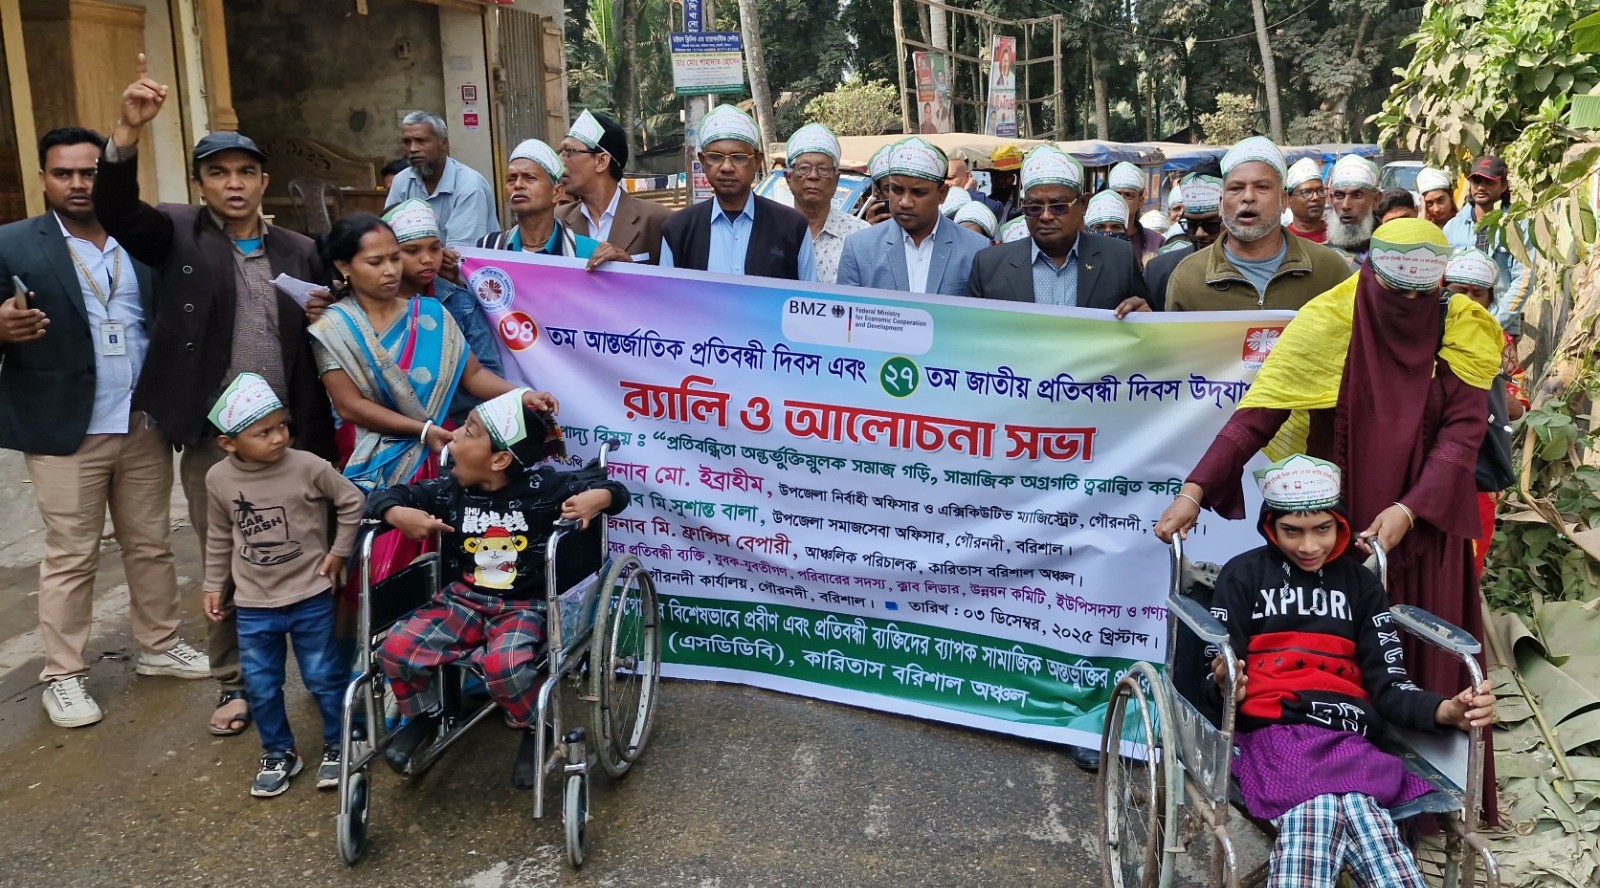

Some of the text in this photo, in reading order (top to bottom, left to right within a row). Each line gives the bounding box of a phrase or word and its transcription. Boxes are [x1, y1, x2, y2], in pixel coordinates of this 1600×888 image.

[789, 300, 827, 317] BMZ
[855, 307, 901, 318] Federal Ministry
[864, 315, 892, 324] Economic
[893, 318, 927, 327] Cooperation
[867, 322, 904, 332] Development
[502, 321, 534, 342] ৩৪
[545, 327, 578, 350] তম
[583, 328, 686, 361] আন্তর্জাতিক
[690, 336, 767, 370] প্রতিবন্ধী
[772, 343, 823, 375] দিবস
[828, 357, 868, 384] এবং
[884, 364, 914, 391] ২৭
[925, 366, 960, 391] তম
[966, 366, 1032, 400] জাতীয়
[1037, 373, 1122, 404] প্রতিবন্ধী
[1127, 373, 1182, 402] দিবস
[740, 397, 771, 432] ও
[784, 400, 995, 458] আলোচনা
[1004, 424, 1097, 461] সভা
[655, 465, 690, 487] মো.
[778, 482, 827, 503] উপজেলা
[831, 488, 868, 507] নির্বাহী
[872, 495, 918, 514] অফিসার
[923, 503, 934, 514] ও
[937, 501, 1013, 523] এক্সিকিউটিভ
[851, 459, 897, 479] সমাজ
[902, 462, 937, 486] গড়ি,
[943, 469, 1015, 490] সামাজিক
[1021, 472, 1080, 493] অগ্রগতি
[1084, 476, 1142, 499] ত্বরান্বিত
[239, 514, 265, 529] CAR
[241, 515, 283, 538] WASH
[464, 506, 481, 516] SHU
[772, 508, 824, 531] উপজেলা
[828, 517, 891, 540] সমাজসেবা
[607, 515, 644, 537] জনাব
[653, 516, 676, 538] মি.
[804, 544, 857, 565] আঞ্চলিক
[928, 560, 982, 578] কারিতাস
[987, 564, 1035, 580] বরিশাল
[629, 541, 674, 560] প্রতিবন্ধী
[798, 568, 850, 587] পরিবারের
[896, 580, 920, 593] ক্লাব
[970, 582, 1006, 600] উন্নয়ন
[1056, 592, 1121, 618] ইউপিসদস্য
[1126, 606, 1137, 618] ও
[908, 600, 948, 615] তারিখ
[963, 608, 985, 620] ০৩
[1053, 623, 1093, 644] ২০২৫
[1252, 586, 1353, 622] XPLOR
[668, 598, 739, 629] বিশেষভাবে
[744, 605, 779, 633] প্রবীণ
[783, 614, 811, 639] এবং
[814, 614, 868, 646] প্রতিবন্ধী
[872, 623, 931, 656] ব্যক্তিদের
[934, 636, 979, 664] ব্যাপক
[981, 646, 1042, 677] সামাজিক
[803, 649, 885, 680] কারিতাস
[891, 663, 965, 696] বরিশাল
[970, 680, 1029, 709] অঞ্চল
